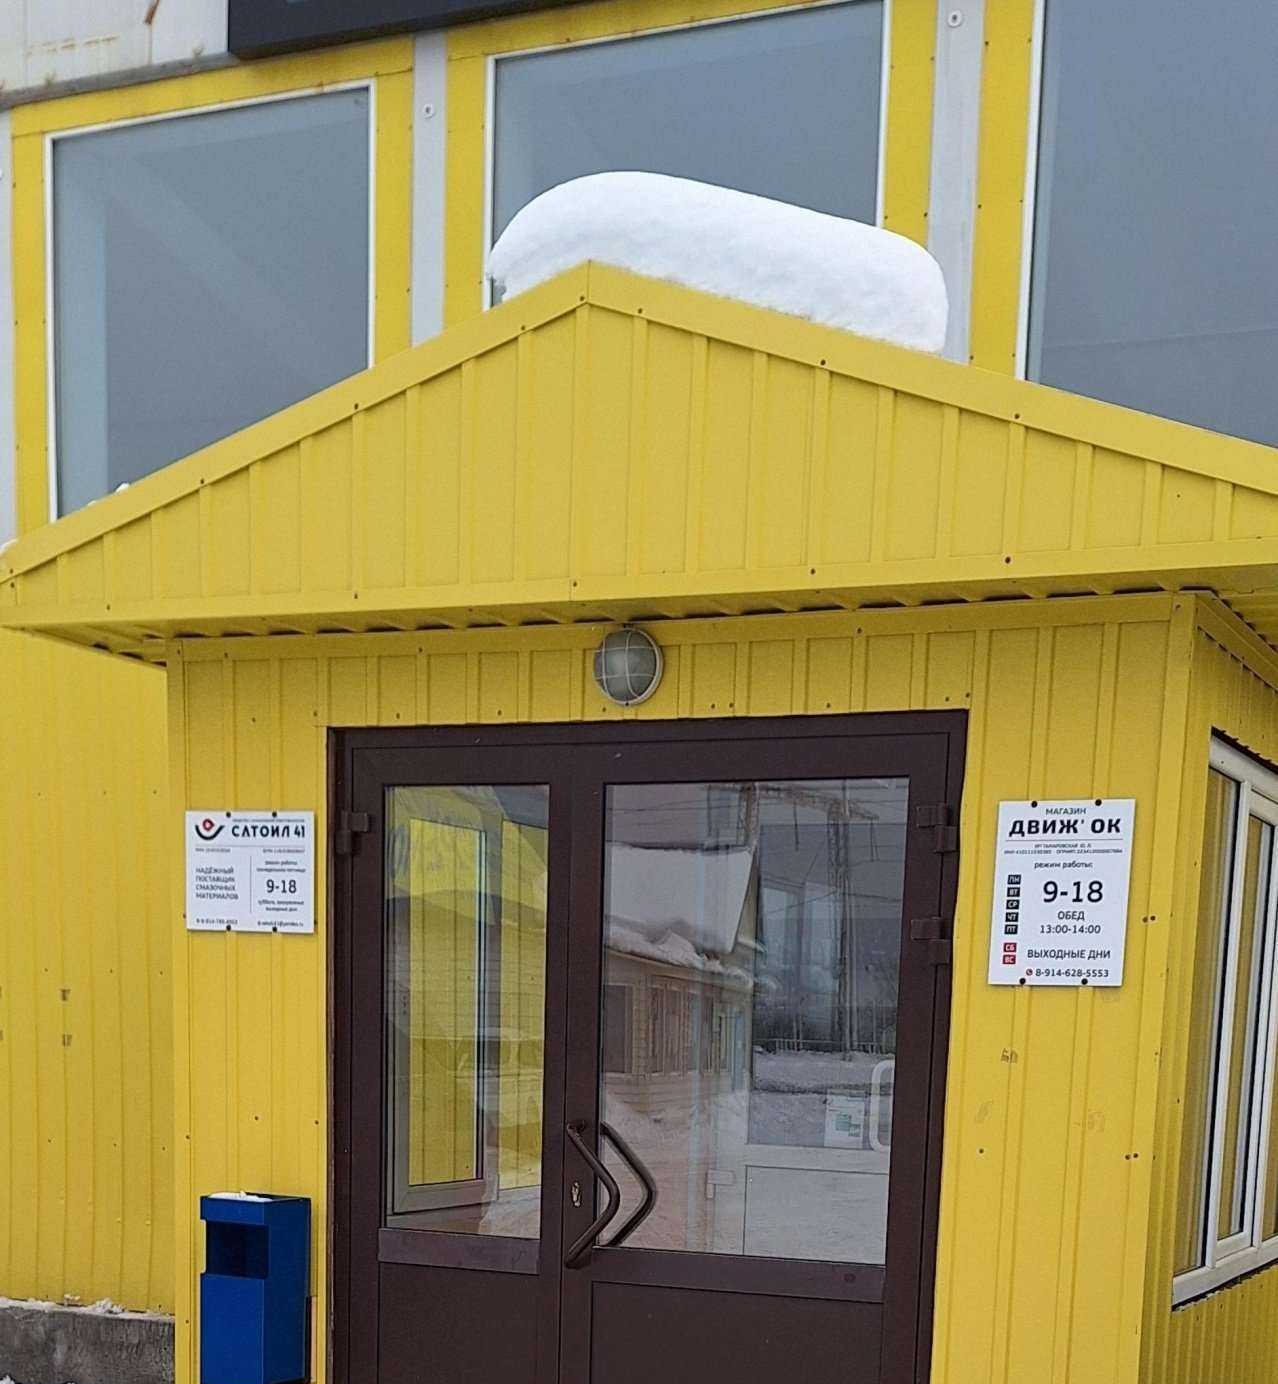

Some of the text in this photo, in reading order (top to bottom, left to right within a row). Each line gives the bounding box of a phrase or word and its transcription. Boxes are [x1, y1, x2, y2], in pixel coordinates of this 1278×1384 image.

[1045, 808, 1087, 816] МАГАЗИН
[1091, 818, 1121, 834] ОК
[294, 825, 305, 838] 41
[1034, 861, 1061, 870] режим
[1008, 875, 1020, 883] ПН
[266, 879, 297, 893] 9-18
[1008, 888, 1019, 896] ВТ
[1043, 880, 1103, 903] 9-18
[1057, 910, 1085, 921] ОБЕД
[1039, 924, 1101, 934] 13:00-14:00
[1027, 949, 1111, 960] ВЫХОДНЫЕ ДНИ
[1035, 968, 1109, 978] 8-914-628-5553
